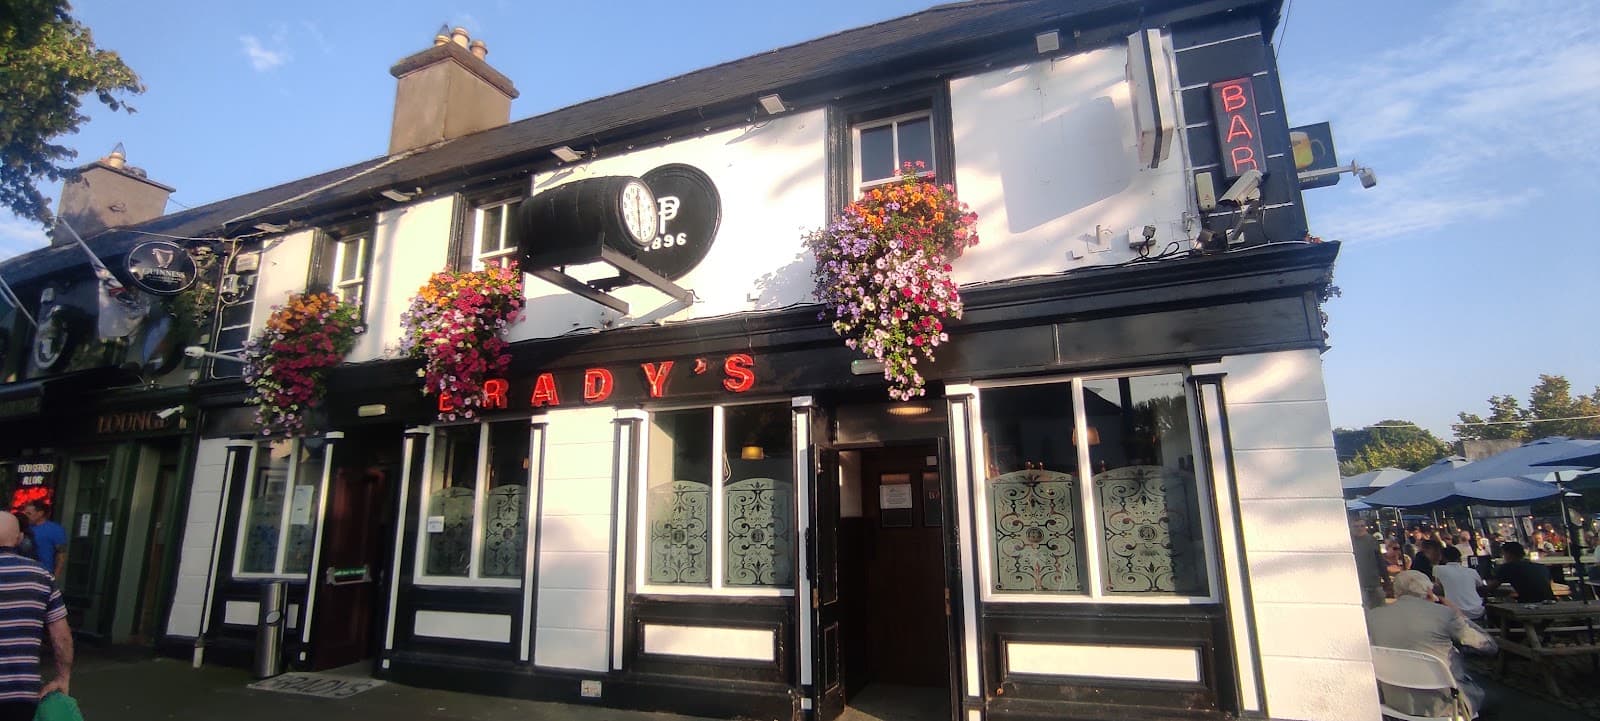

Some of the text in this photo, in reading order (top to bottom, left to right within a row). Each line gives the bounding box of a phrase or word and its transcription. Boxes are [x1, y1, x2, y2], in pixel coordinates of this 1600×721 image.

[1221, 84, 1258, 175] BAR
[643, 232, 687, 252] 896
[142, 267, 186, 279] GUINNESS
